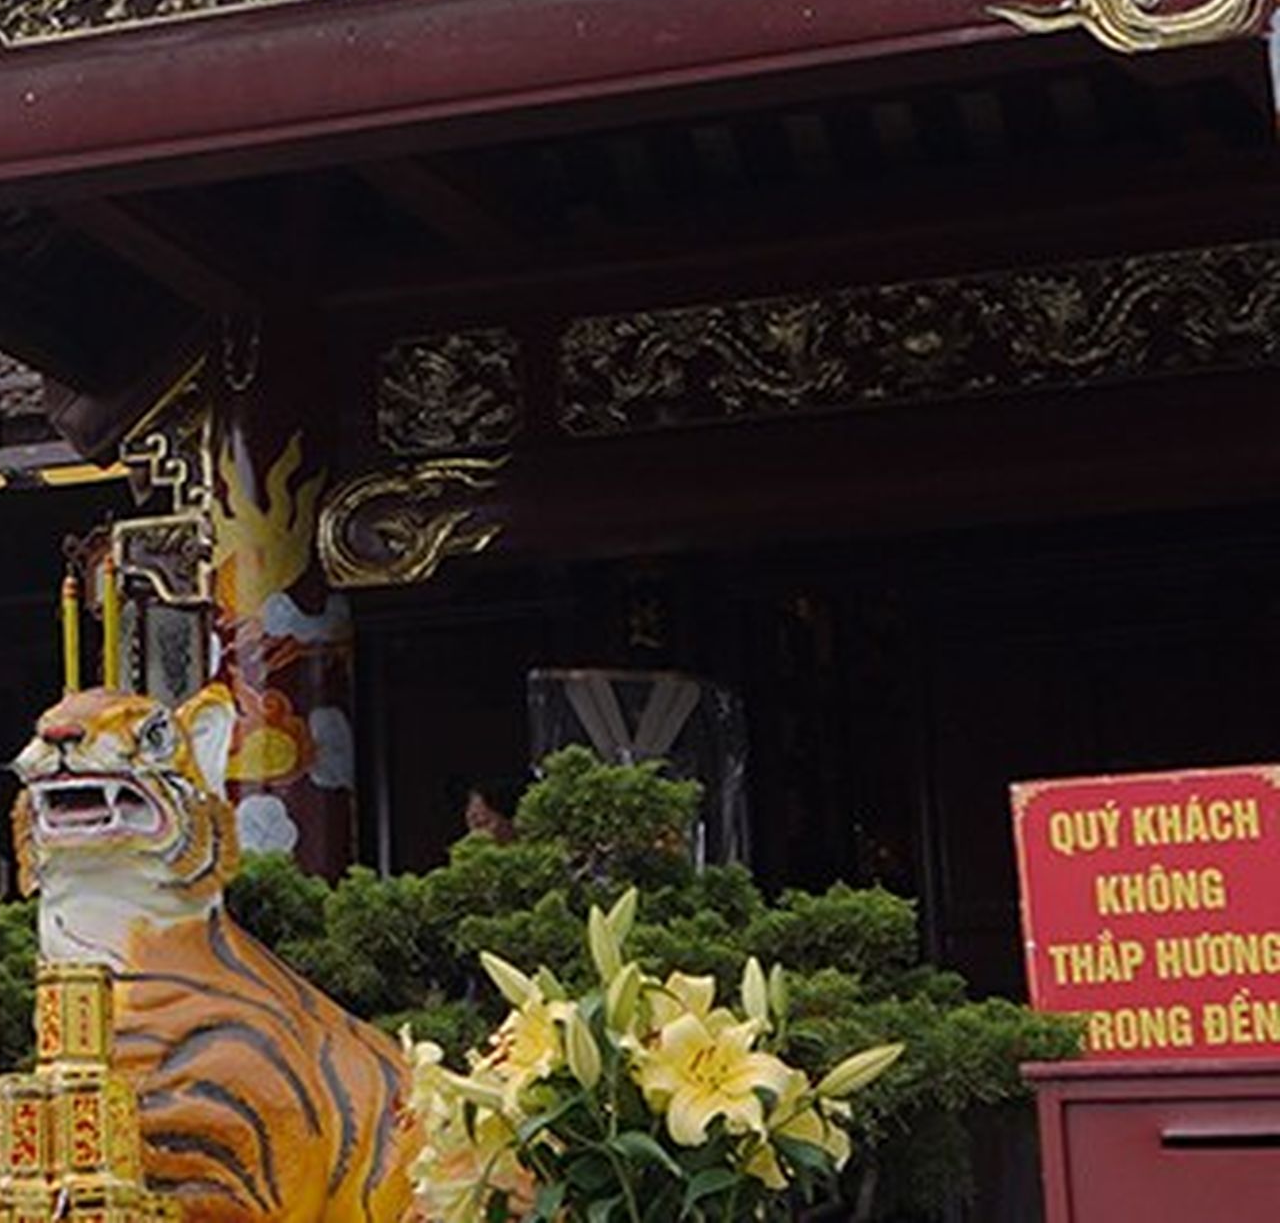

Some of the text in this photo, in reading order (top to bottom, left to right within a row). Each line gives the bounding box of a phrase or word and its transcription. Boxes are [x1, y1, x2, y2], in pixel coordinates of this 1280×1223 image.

[1050, 795, 1259, 855] QUÝ KHÁCH
[1096, 864, 1225, 915] KHÔNG
[1156, 932, 1280, 979] HƯƠNG
[1203, 988, 1280, 1045] ĐỀN
